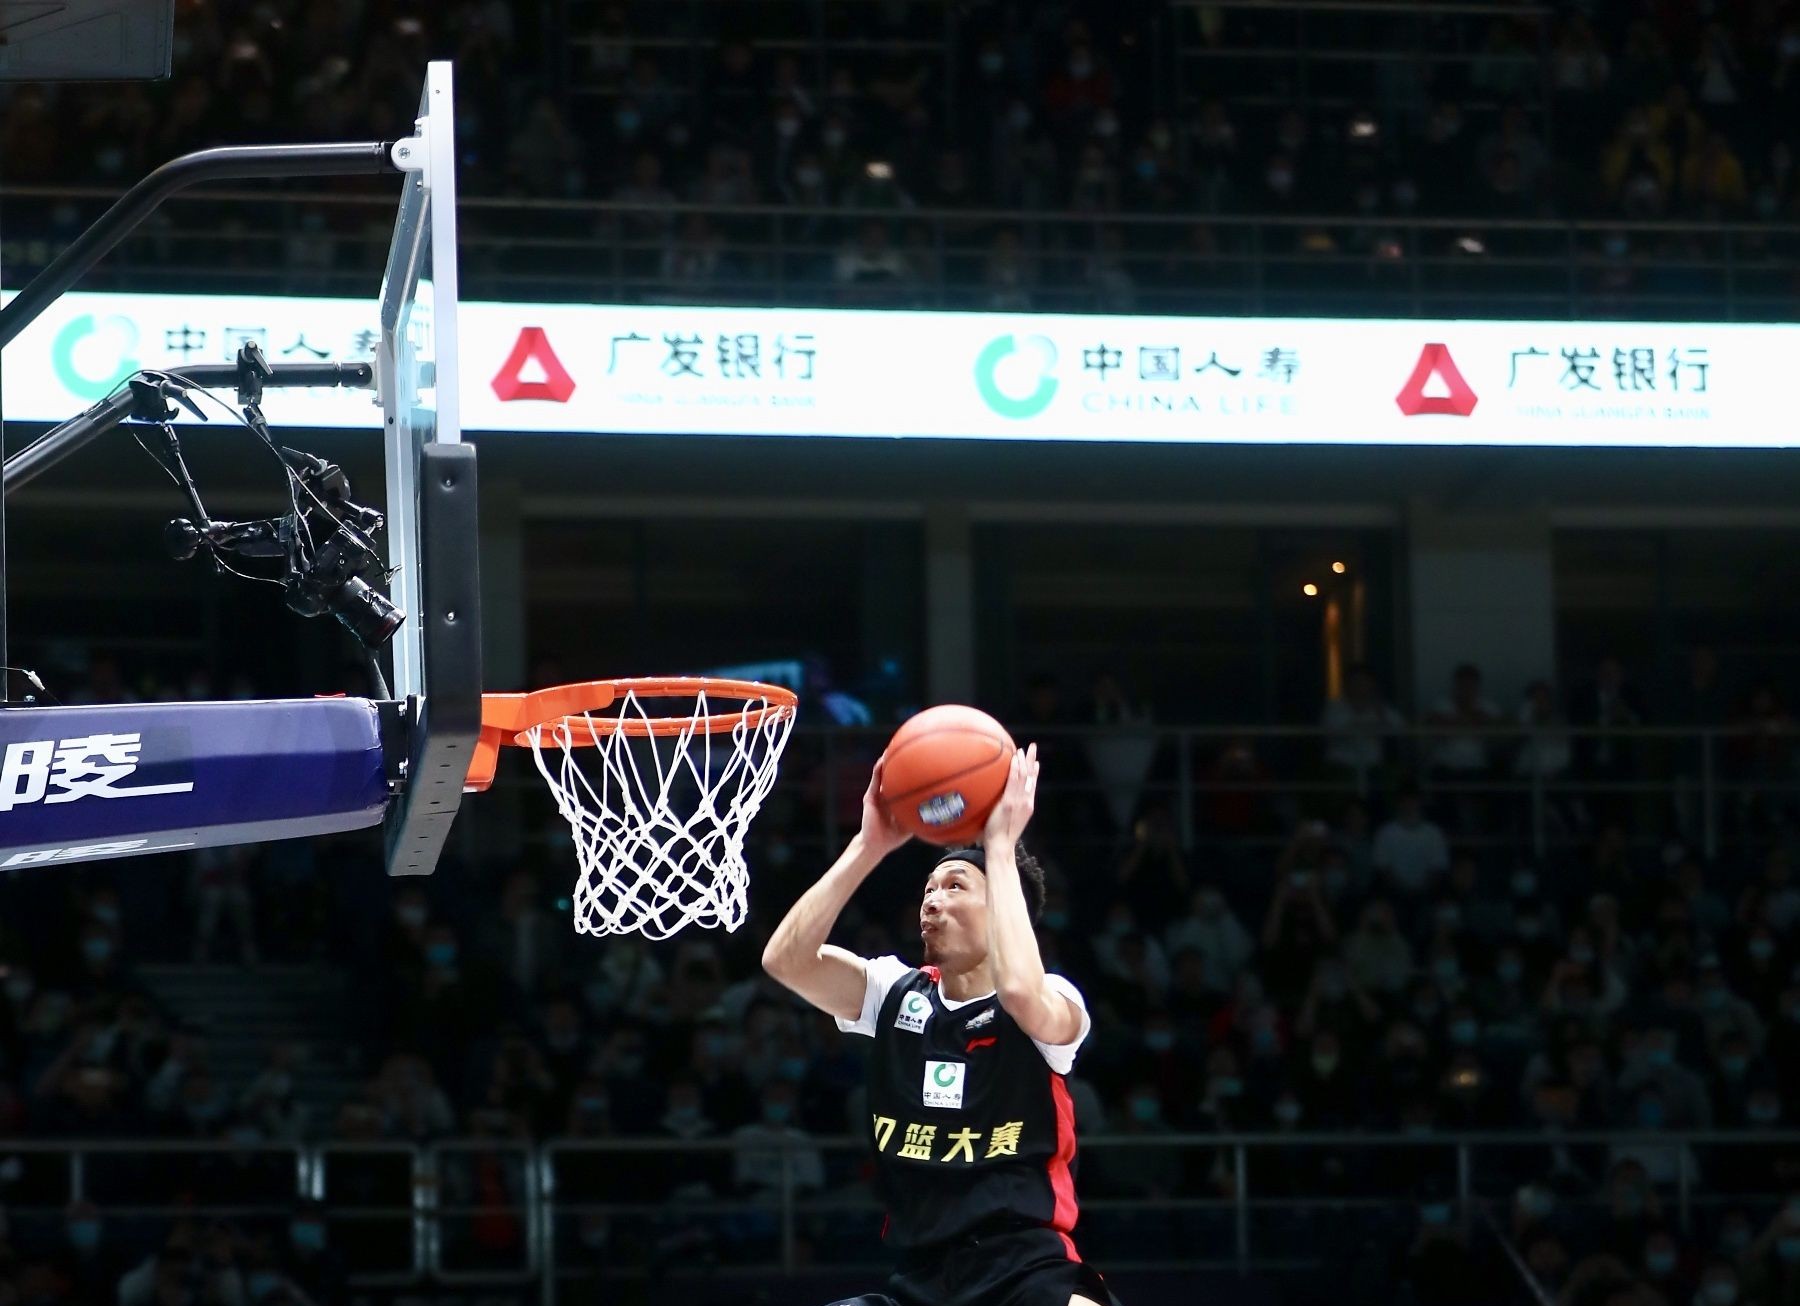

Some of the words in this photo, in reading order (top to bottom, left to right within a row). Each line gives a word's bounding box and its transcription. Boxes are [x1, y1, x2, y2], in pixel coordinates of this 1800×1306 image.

[606, 332, 817, 380] 广发银行
[1082, 342, 1300, 384] 中国人寿
[1507, 346, 1710, 392] 广发银行
[1082, 392, 1200, 413] CHINA
[1218, 395, 1298, 415] LIFE
